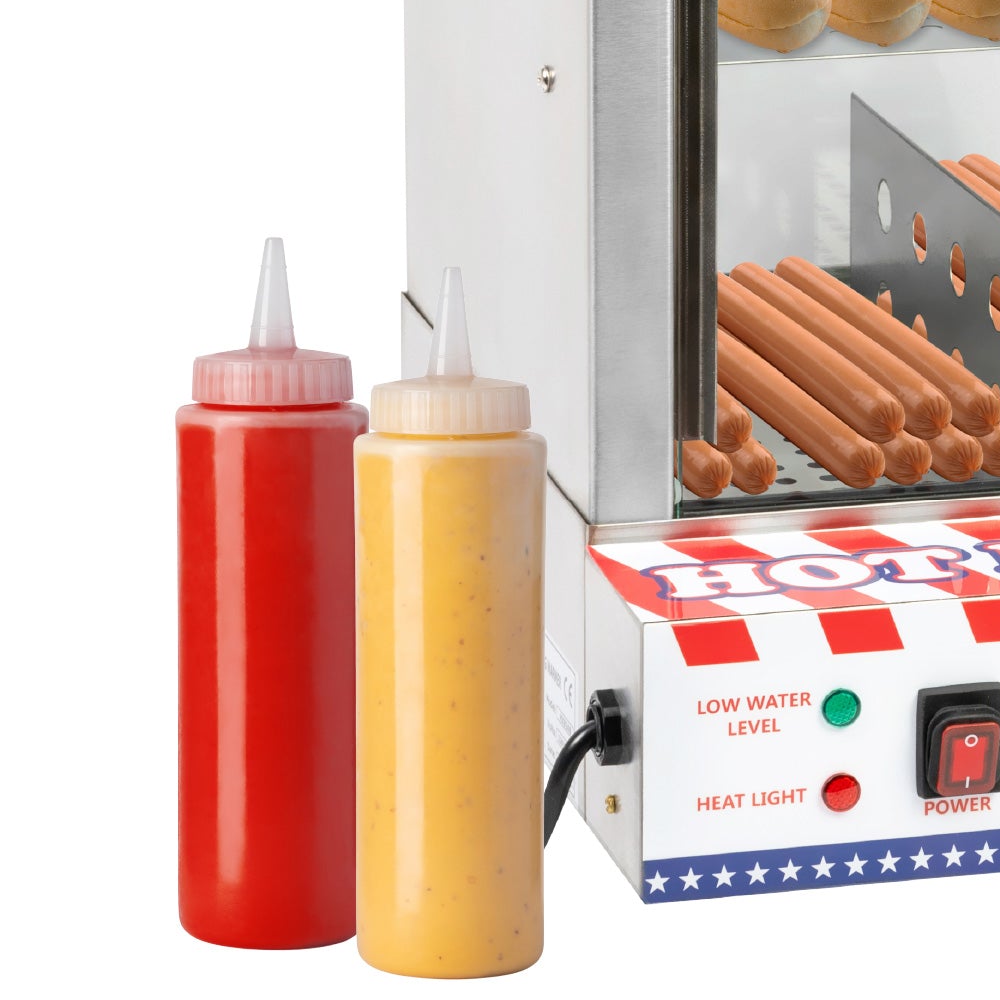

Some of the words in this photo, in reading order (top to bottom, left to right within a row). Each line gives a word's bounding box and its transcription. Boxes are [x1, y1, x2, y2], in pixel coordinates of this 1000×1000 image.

[643, 546, 968, 599] HOT
[697, 698, 741, 715] LOW
[746, 692, 812, 711] WATER
[727, 718, 781, 737] LEVEL
[697, 793, 746, 812] HEAT
[751, 787, 808, 807] LIGHT
[924, 796, 992, 816] POWER
